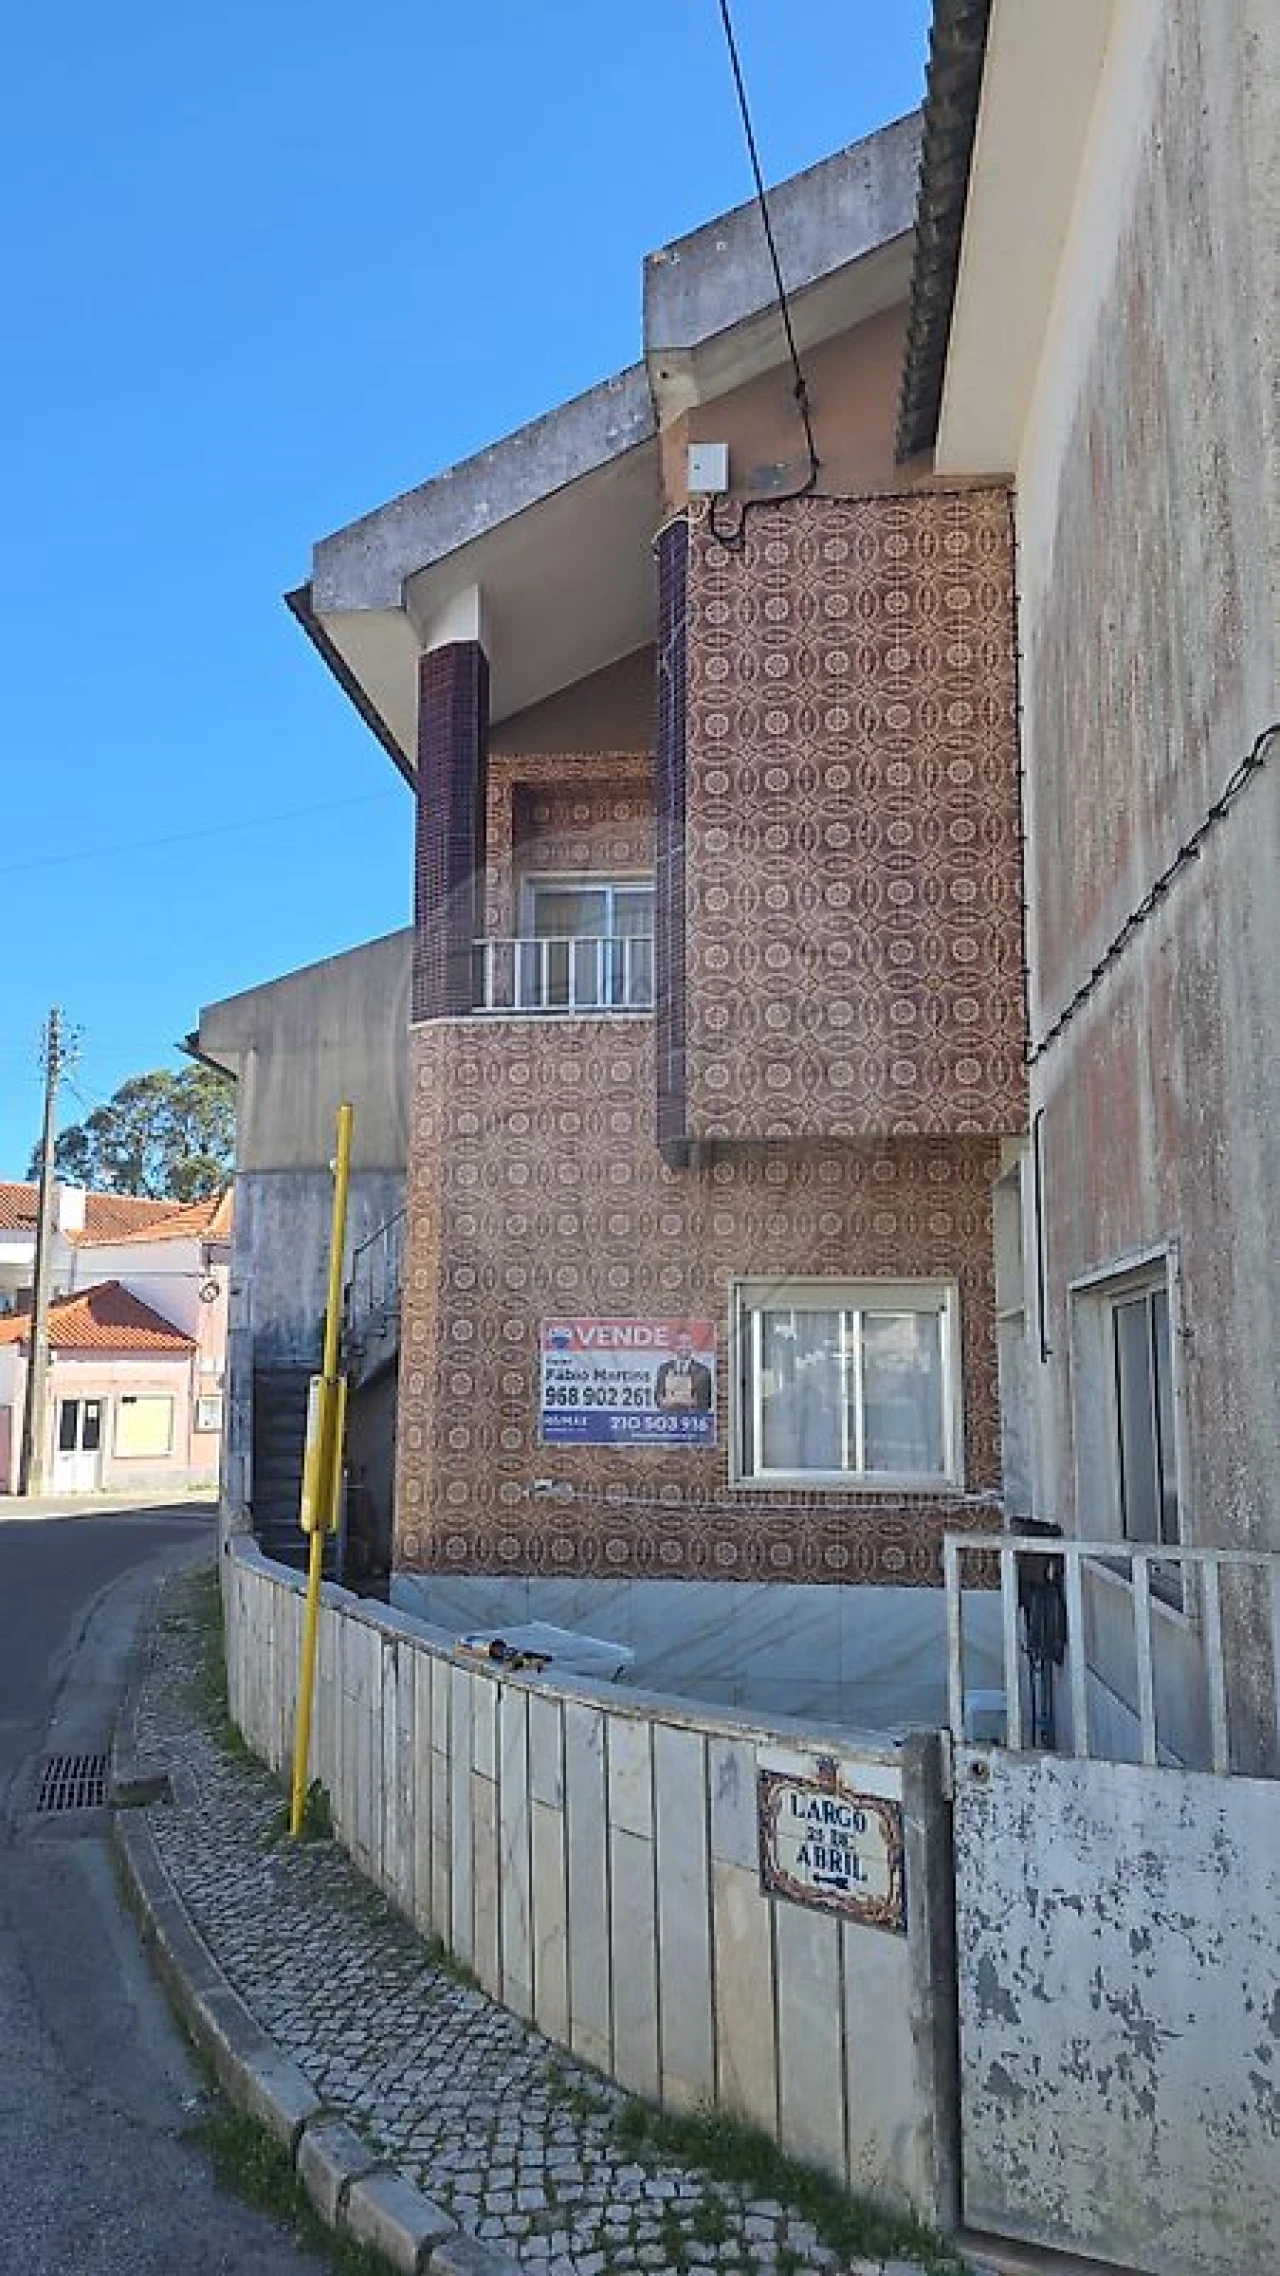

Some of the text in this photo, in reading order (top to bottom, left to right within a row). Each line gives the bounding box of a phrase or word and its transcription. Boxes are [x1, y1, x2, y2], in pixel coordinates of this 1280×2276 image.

[576, 1325, 670, 1346] VENDE
[545, 1385, 652, 1406] 968 902 261
[610, 1416, 641, 1430] 210
[645, 1416, 678, 1431] 503
[791, 1794, 867, 1833] LARGO
[796, 1845, 868, 1881] ABRIL
